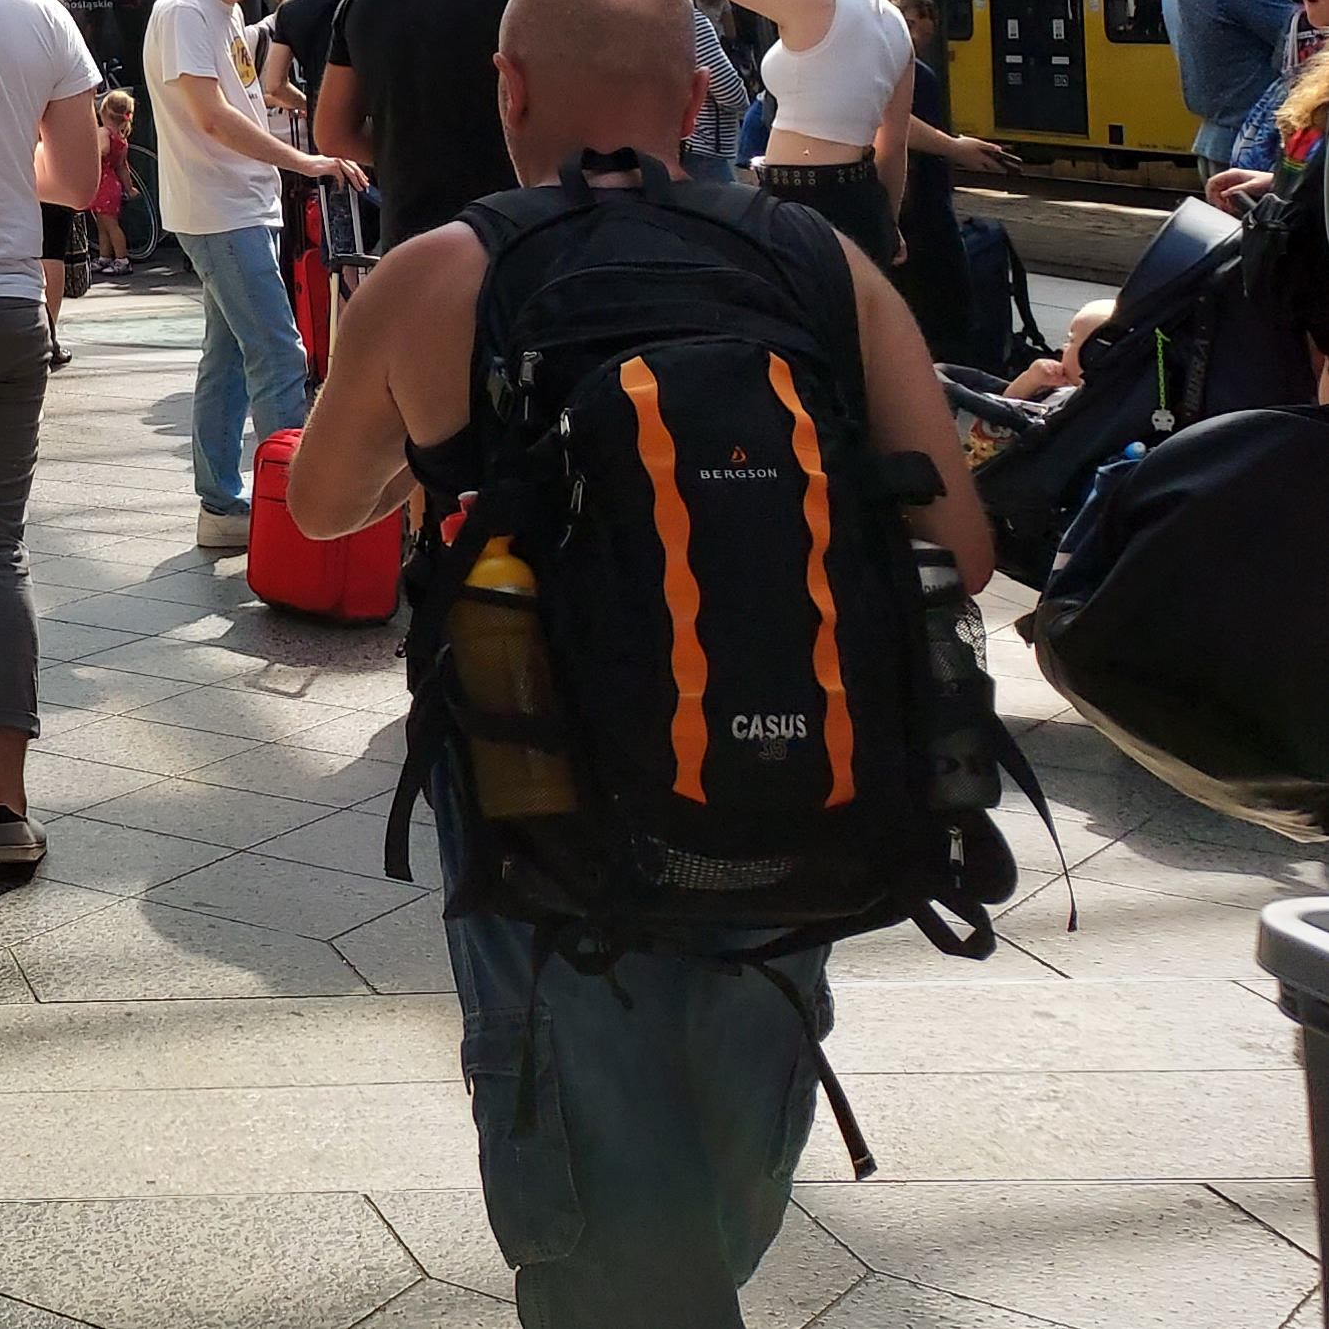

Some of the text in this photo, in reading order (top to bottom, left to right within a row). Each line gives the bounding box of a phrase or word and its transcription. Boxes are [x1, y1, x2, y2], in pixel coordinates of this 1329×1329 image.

[64, 0, 113, 11] nośląskie
[699, 468, 778, 480] BERGSON
[731, 714, 808, 741] CASUS
